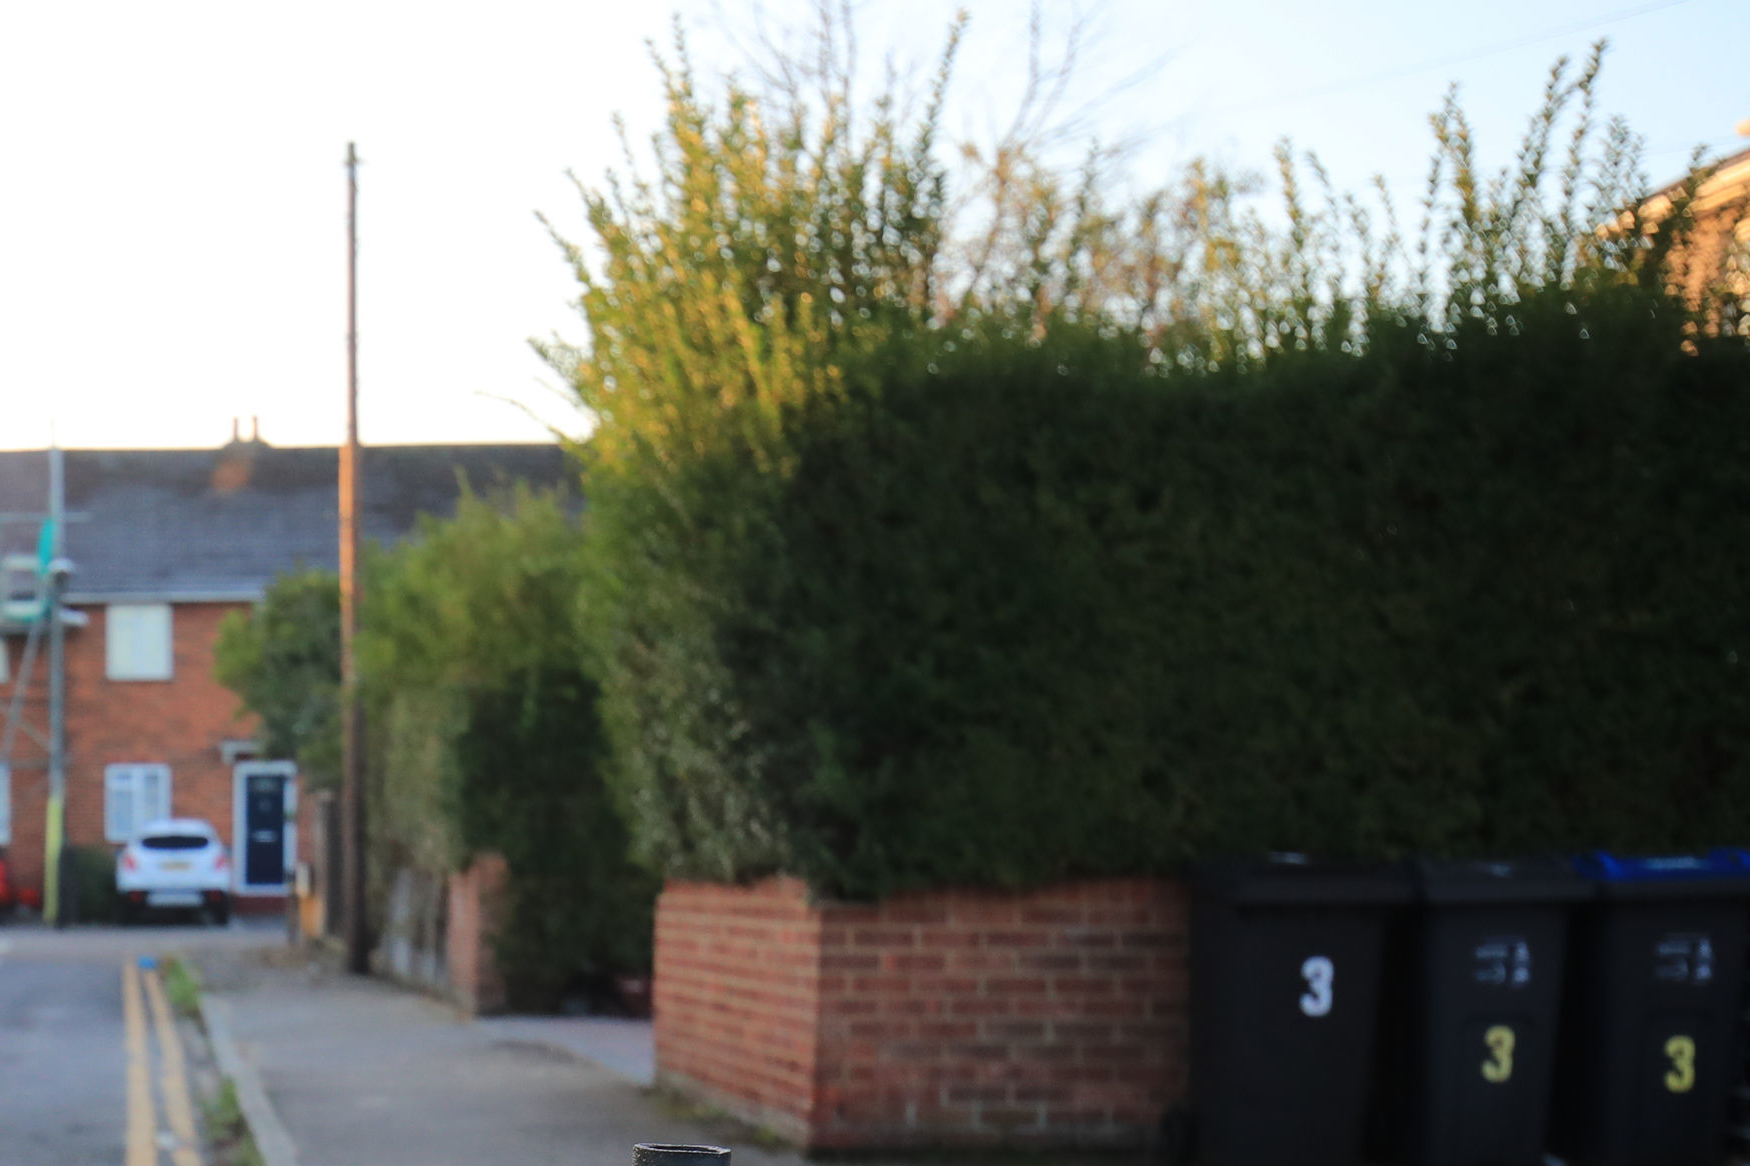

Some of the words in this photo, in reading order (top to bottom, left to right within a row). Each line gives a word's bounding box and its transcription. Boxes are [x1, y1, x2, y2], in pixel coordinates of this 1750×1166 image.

[1298, 955, 1335, 1018] 3
[1480, 1024, 1517, 1083] 3
[1664, 1034, 1697, 1093] 3
